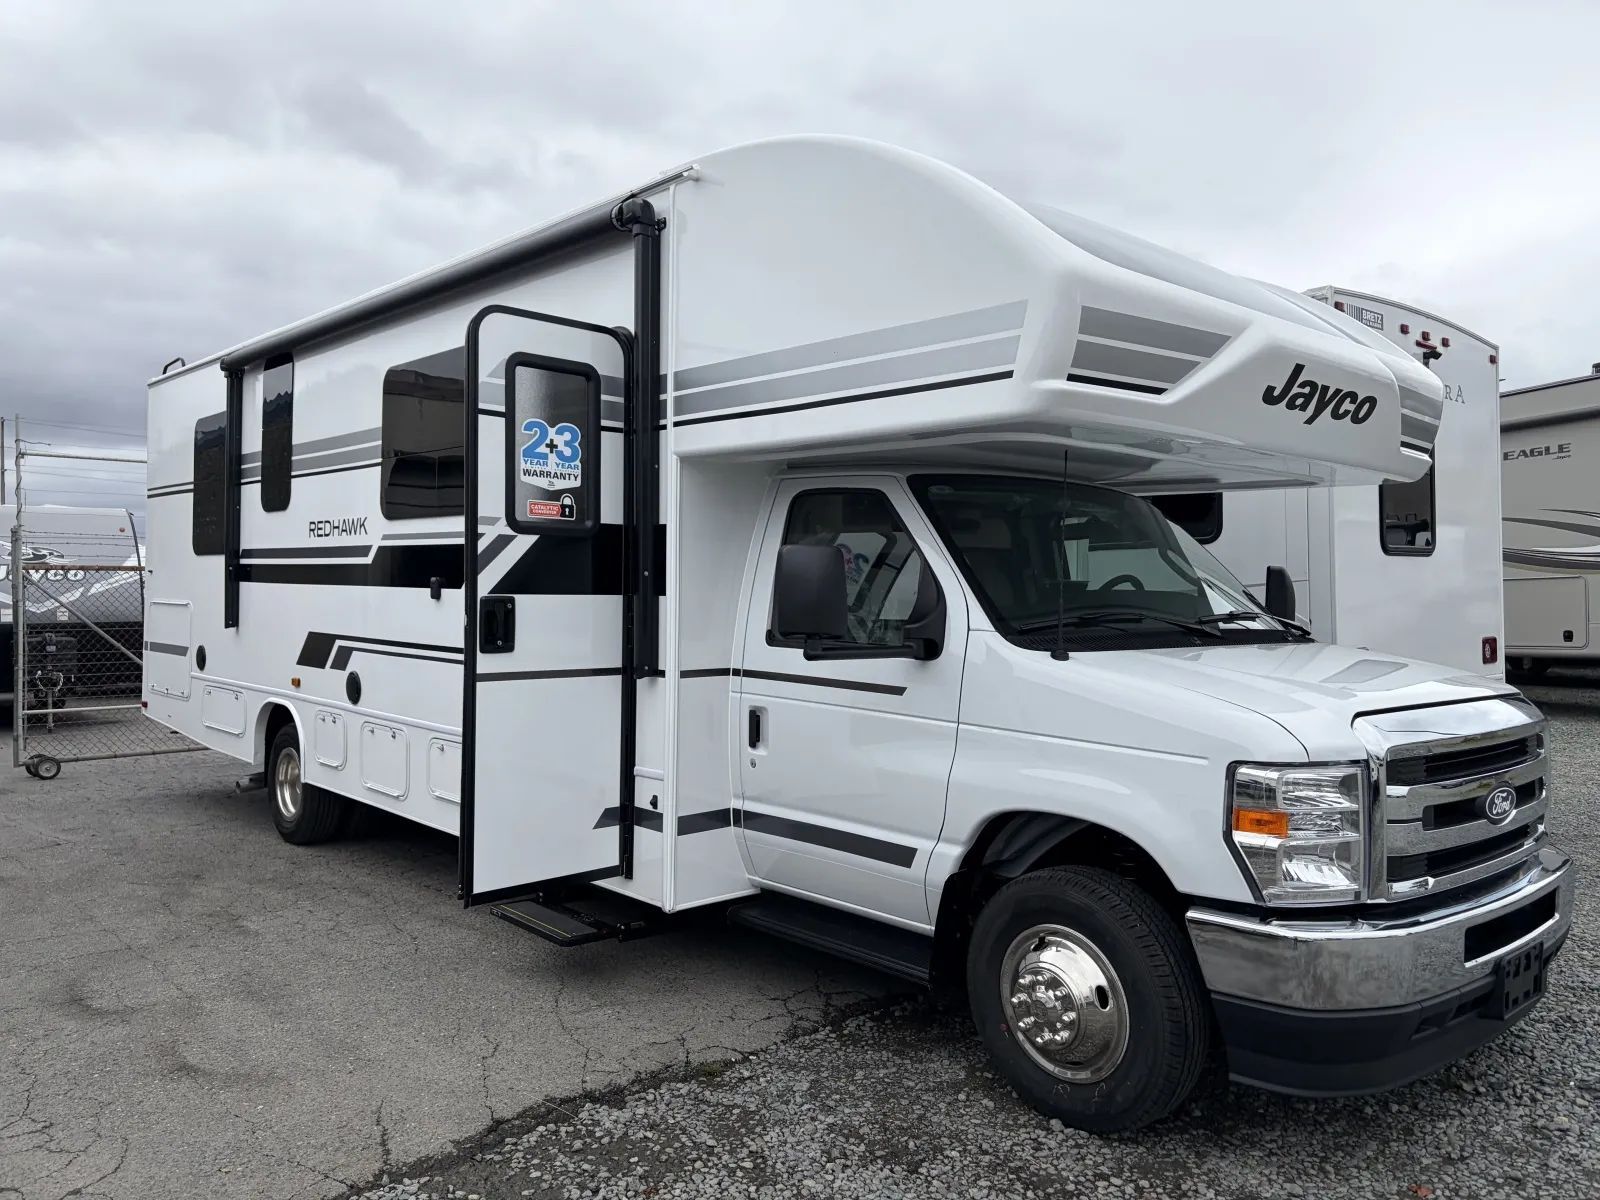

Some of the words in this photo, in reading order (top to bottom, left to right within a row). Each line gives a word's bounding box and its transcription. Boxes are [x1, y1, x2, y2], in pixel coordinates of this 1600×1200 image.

[1362, 310, 1382, 324] BRETZ
[1261, 362, 1378, 426] Jayco
[1444, 384, 1465, 404] RA
[1503, 442, 1572, 461] EAGLE
[523, 458, 549, 468] YEAR
[554, 461, 580, 471] YEAR
[522, 468, 580, 482] WARRANTY
[308, 516, 368, 538] REDHAWK
